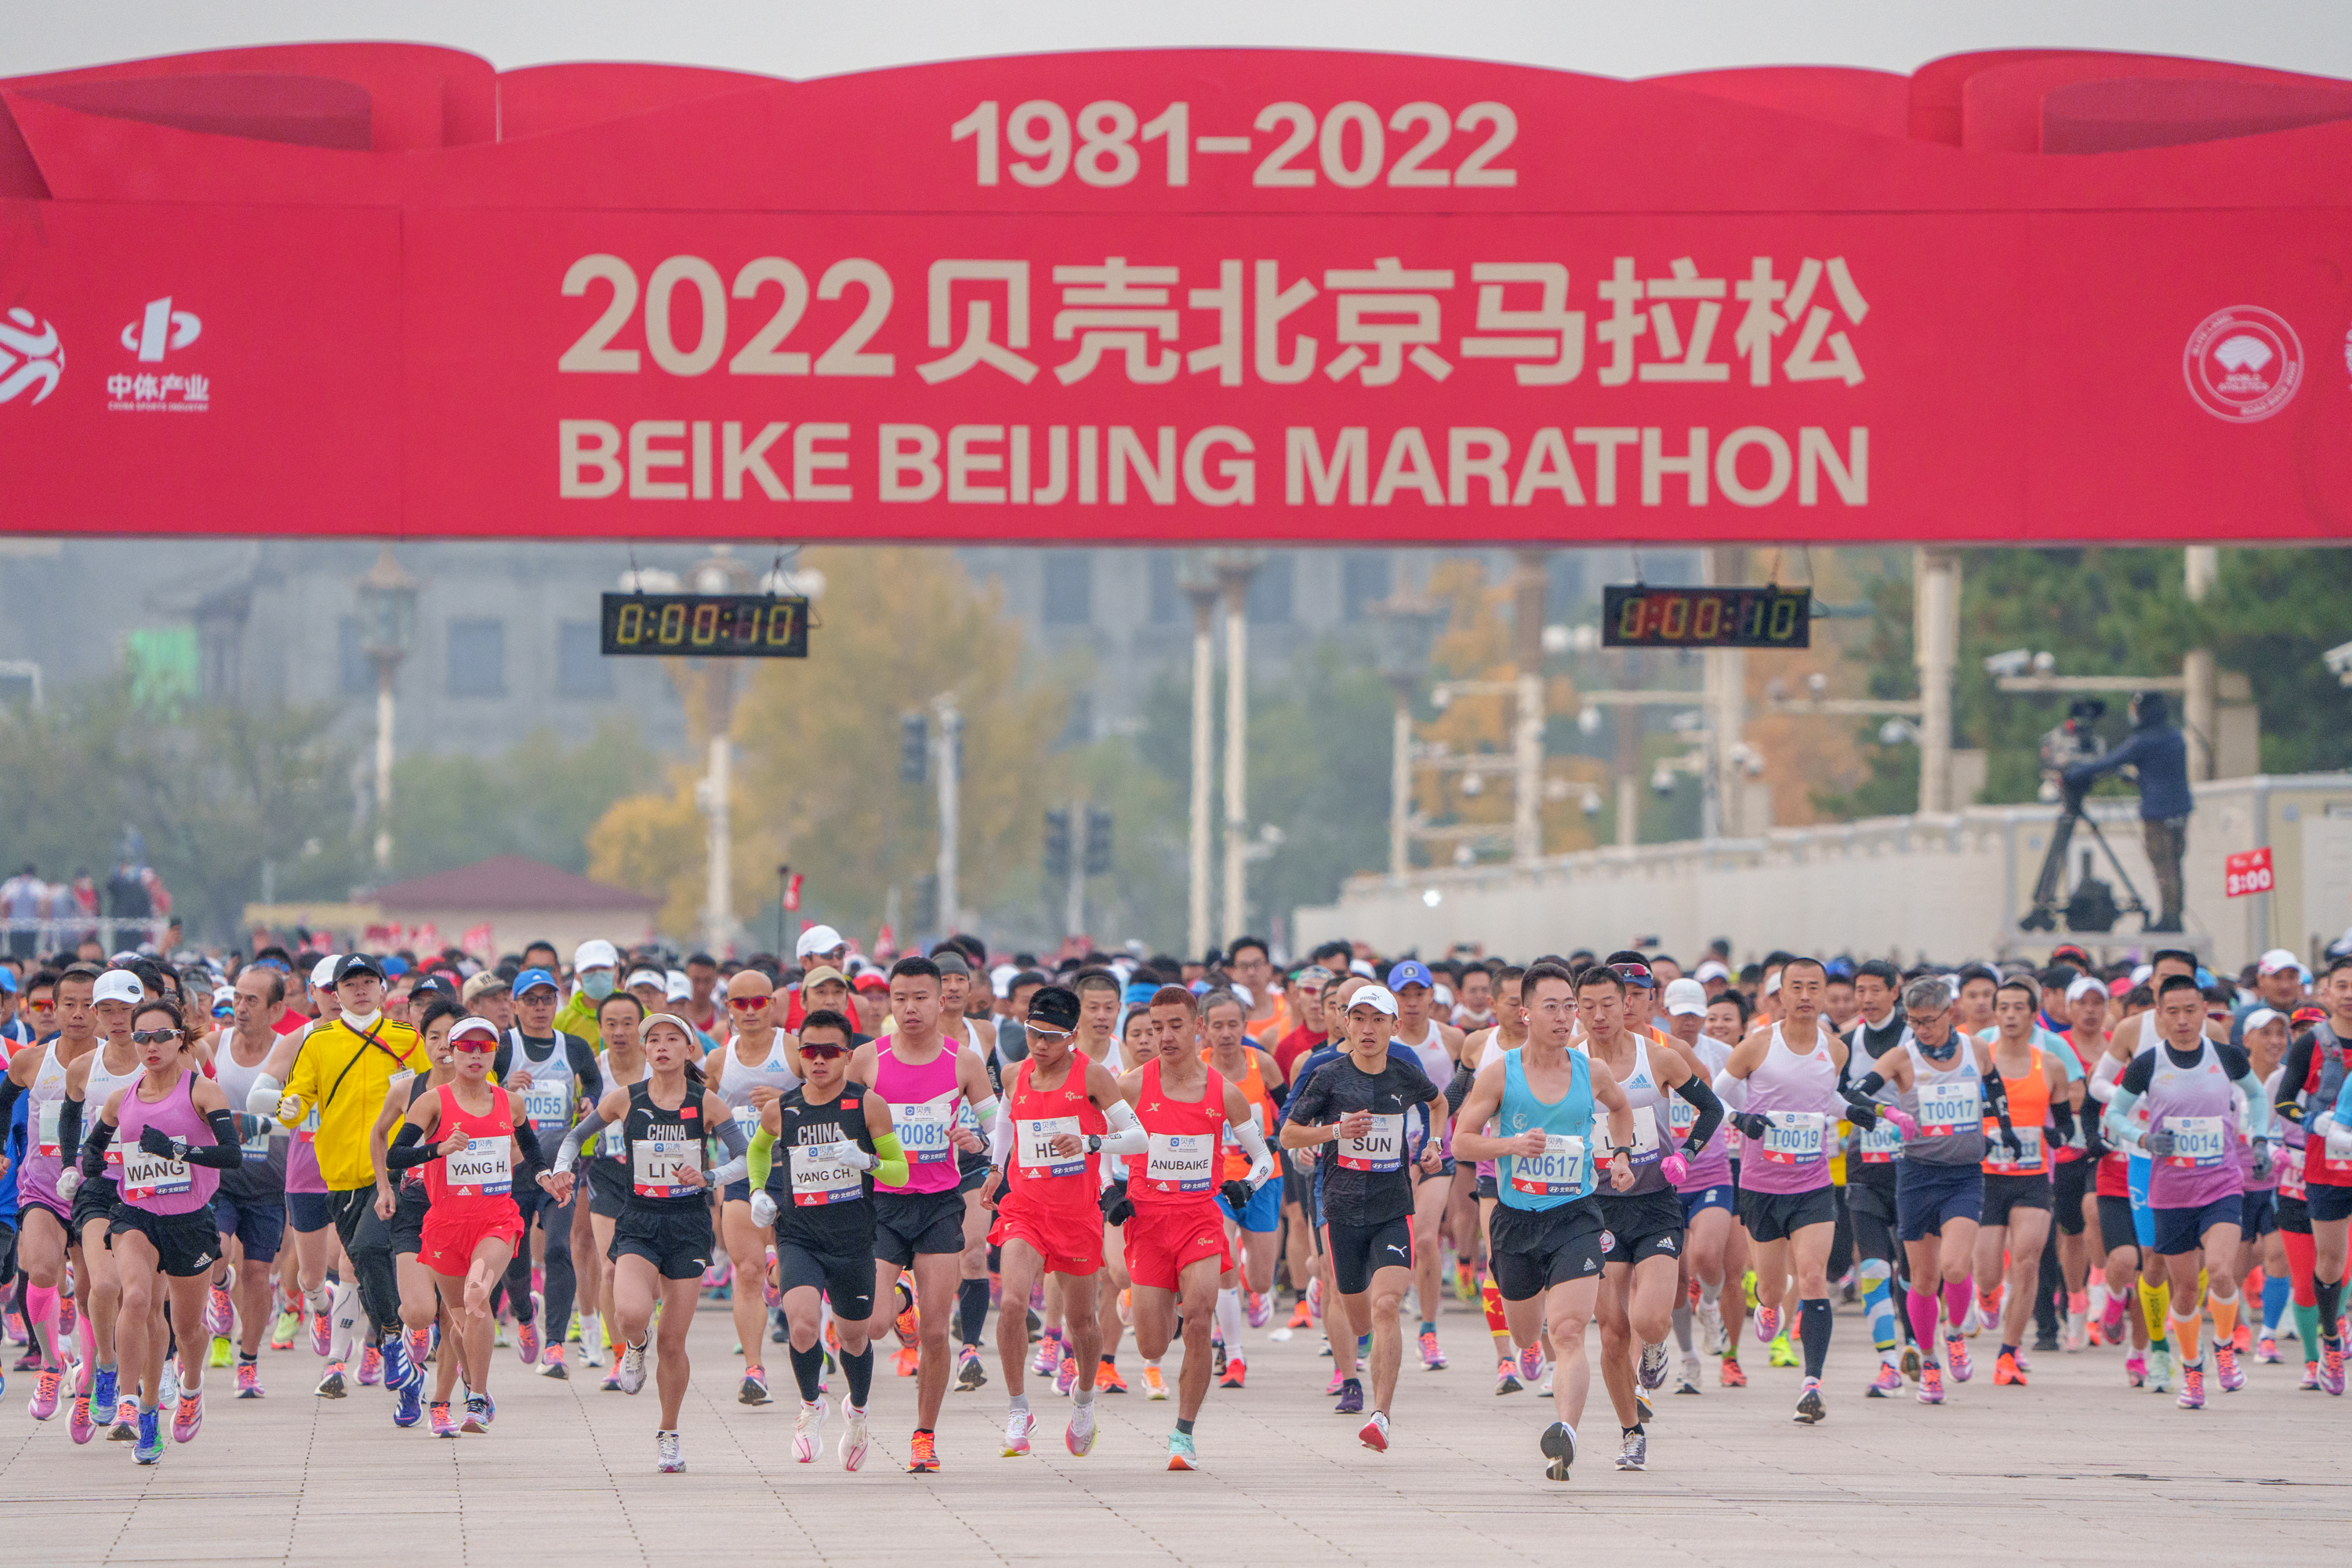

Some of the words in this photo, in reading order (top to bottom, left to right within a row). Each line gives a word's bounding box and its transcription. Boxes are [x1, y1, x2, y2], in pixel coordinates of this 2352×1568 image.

[951, 100, 1519, 188] 1981-2022
[107, 372, 209, 401] 中体产业
[558, 419, 853, 502] BEIKE
[878, 423, 1256, 507] BEIJING
[1284, 426, 1870, 507] MARATHON
[616, 603, 794, 645] 0:00:10
[916, 1105, 932, 1114] 贝壳
[1924, 1099, 1974, 1120] T0017
[647, 1123, 688, 1141] CHINA
[1042, 1120, 1057, 1129] 贝壳
[797, 1121, 841, 1145] CHINA
[893, 1123, 944, 1145] T0081
[1548, 1137, 1563, 1145] 贝壳
[1770, 1129, 1819, 1149] T0019
[1035, 1142, 1061, 1159] HE
[1352, 1137, 1392, 1152] SUN
[127, 1161, 185, 1182] WANG
[452, 1162, 492, 1176] YANG
[496, 1160, 507, 1173] H.
[648, 1163, 665, 1178] LI
[1063, 1163, 1085, 1174] 北京现代
[1150, 1159, 1209, 1171] ANUBAIKE
[1515, 1155, 1579, 1178] A0617
[797, 1171, 829, 1184] YANG
[833, 1168, 854, 1180] CH.
[168, 1185, 190, 1194] 北京现代
[1657, 1243, 1676, 1251] adidas
[194, 1257, 212, 1269] adidas
